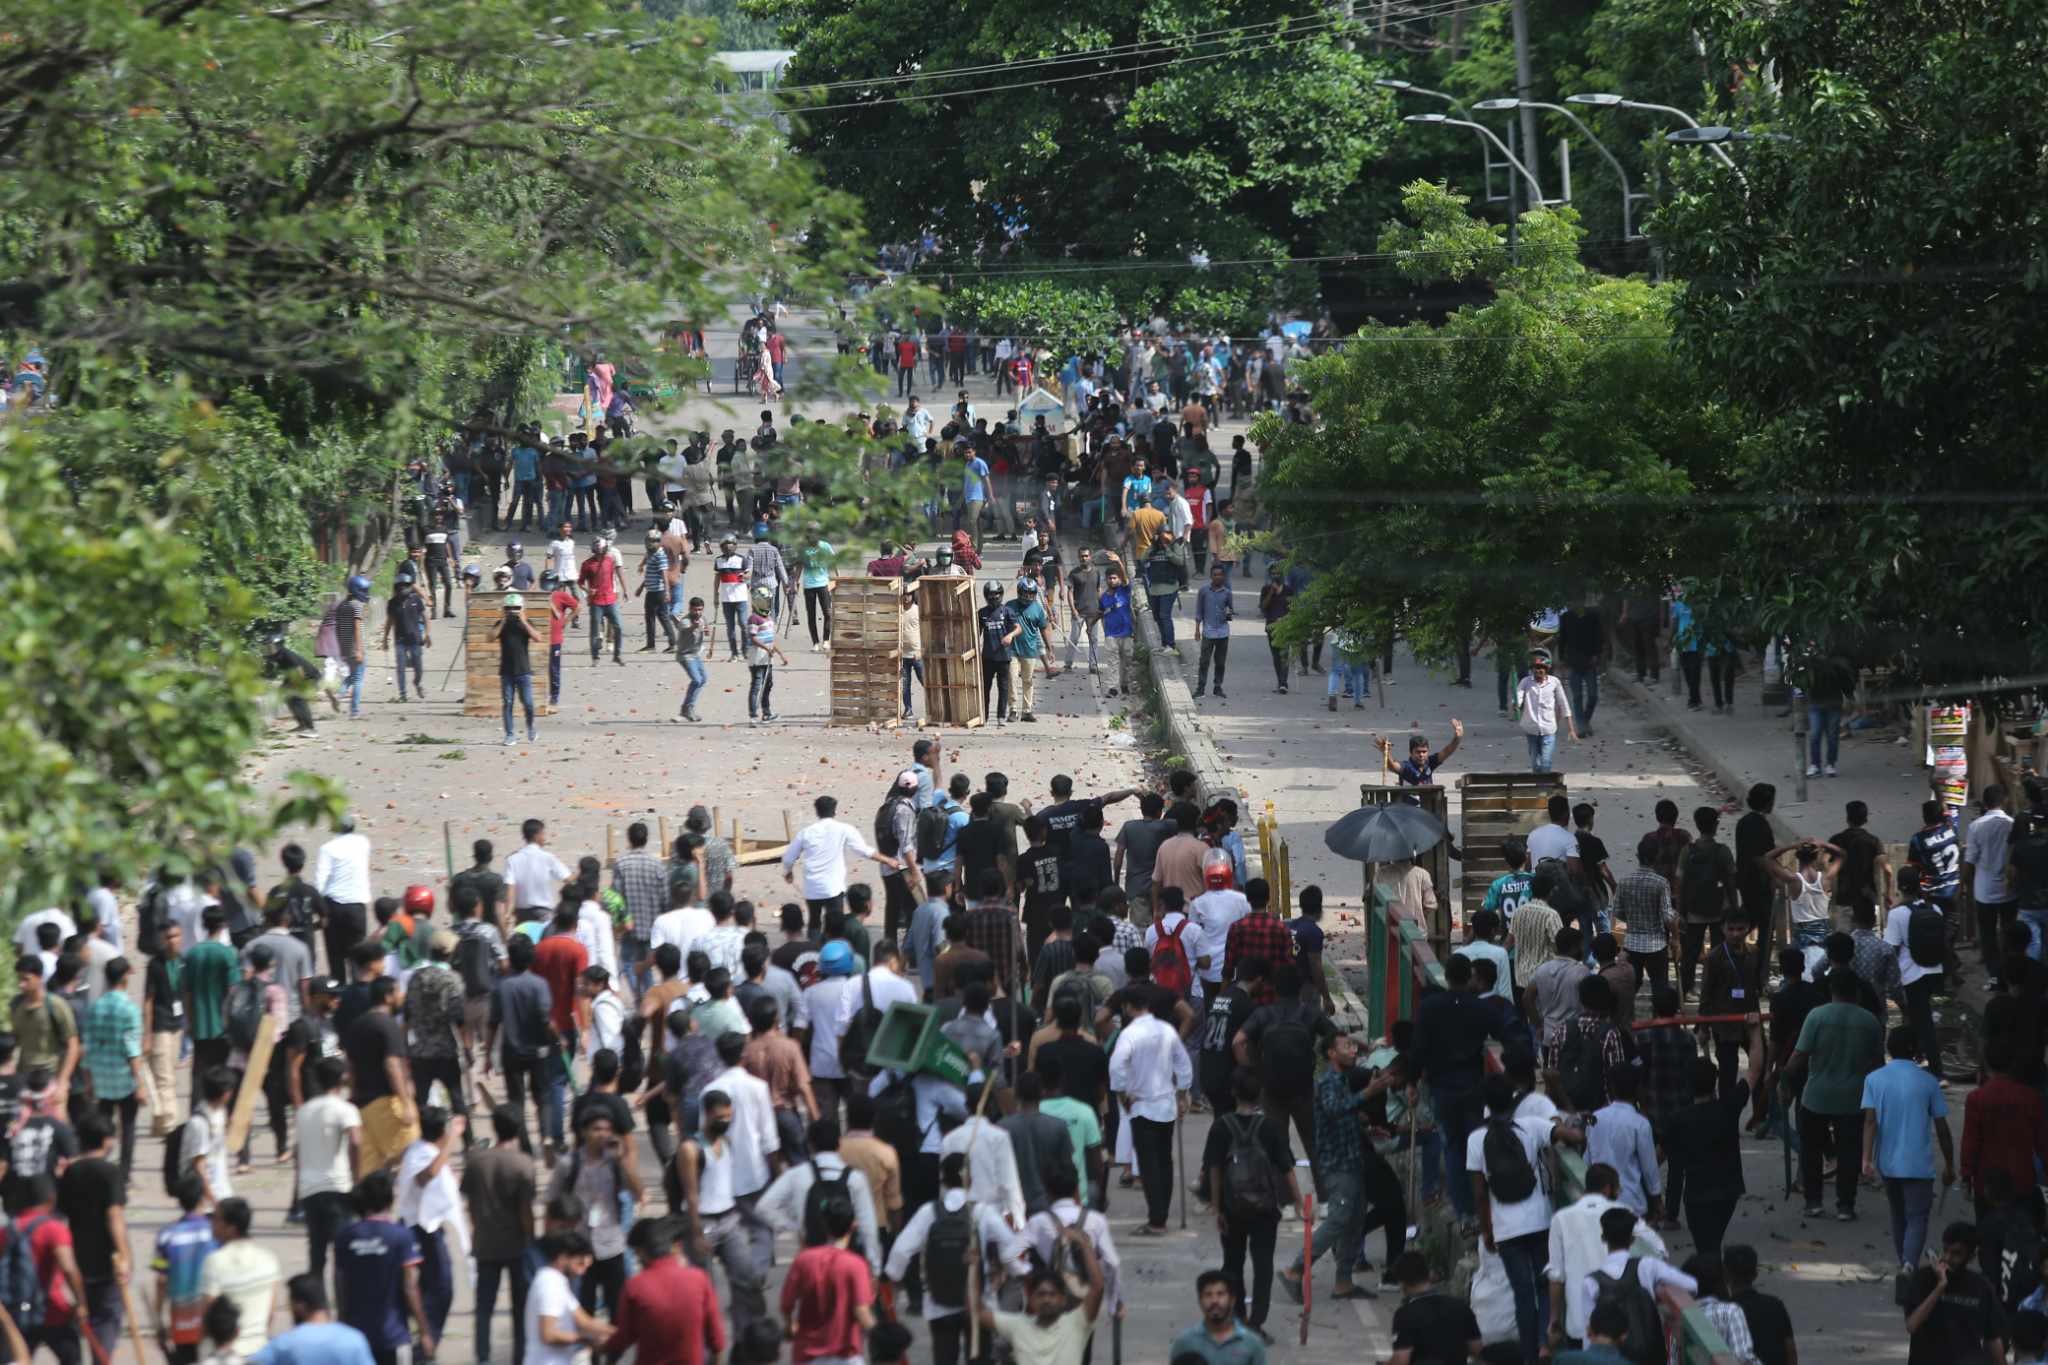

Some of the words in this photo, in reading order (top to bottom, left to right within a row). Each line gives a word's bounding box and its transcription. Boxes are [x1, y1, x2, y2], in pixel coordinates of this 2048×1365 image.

[1034, 857, 1057, 867] BATCH
[1501, 881, 1530, 894] ASHIK
[1203, 1015, 1228, 1051] 24
